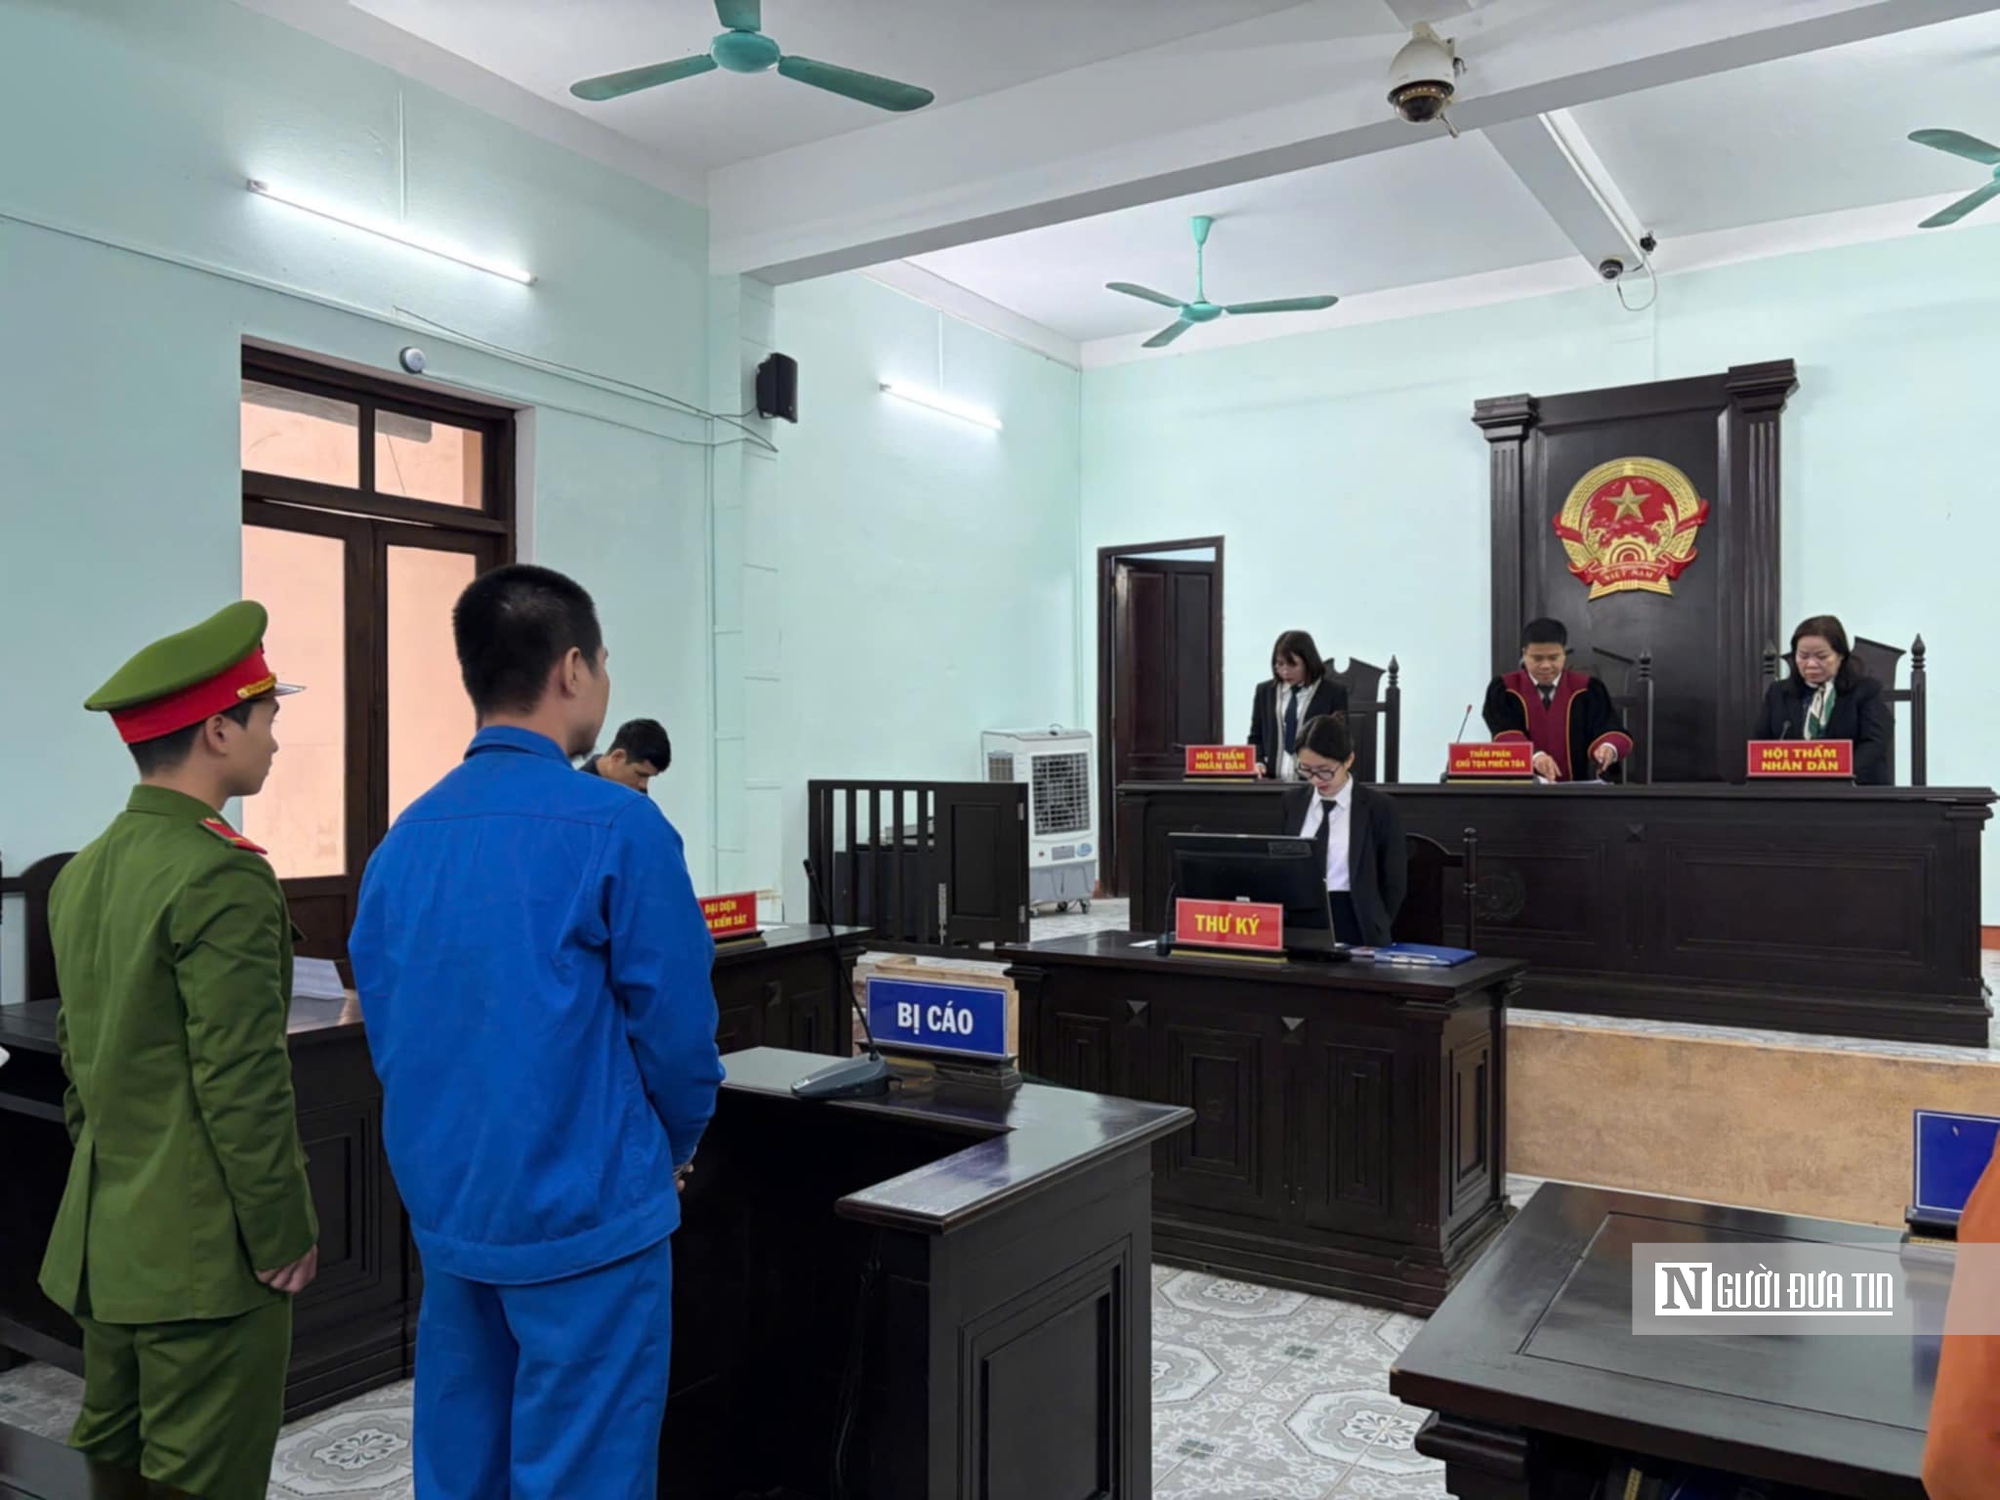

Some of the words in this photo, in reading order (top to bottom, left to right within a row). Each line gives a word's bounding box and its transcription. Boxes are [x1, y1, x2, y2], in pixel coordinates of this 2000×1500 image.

[1196, 750, 1213, 760] HỘI
[1763, 747, 1788, 759] HỘI
[1792, 744, 1837, 759] THẨM
[1195, 760, 1222, 770] NHÂN
[1761, 759, 1802, 771] NHÂN
[1806, 759, 1839, 771] DÂN
[1195, 913, 1232, 934] THƯ
[1235, 913, 1260, 936] KÝ
[897, 1001, 920, 1035] BỊ
[927, 1000, 974, 1036] CÁO
